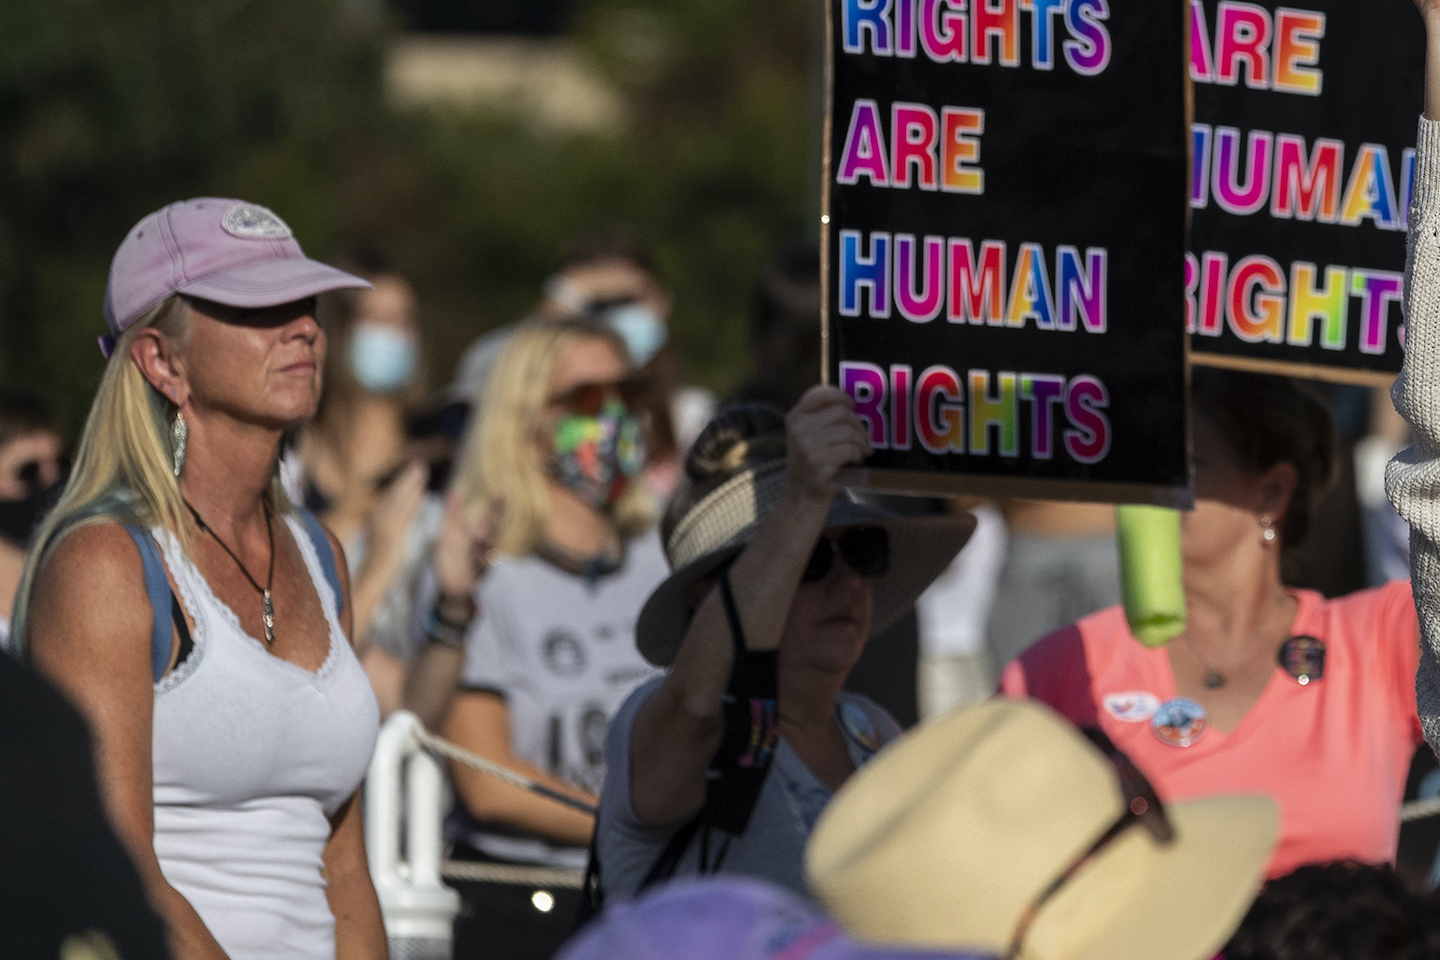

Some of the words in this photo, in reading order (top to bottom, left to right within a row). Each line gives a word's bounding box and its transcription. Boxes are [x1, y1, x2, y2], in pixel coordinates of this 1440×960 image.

[836, 99, 986, 194] ARE
[837, 230, 1109, 333] HUMAN
[1184, 249, 1406, 356] IGHT
[838, 361, 1111, 464] RIGHTS
